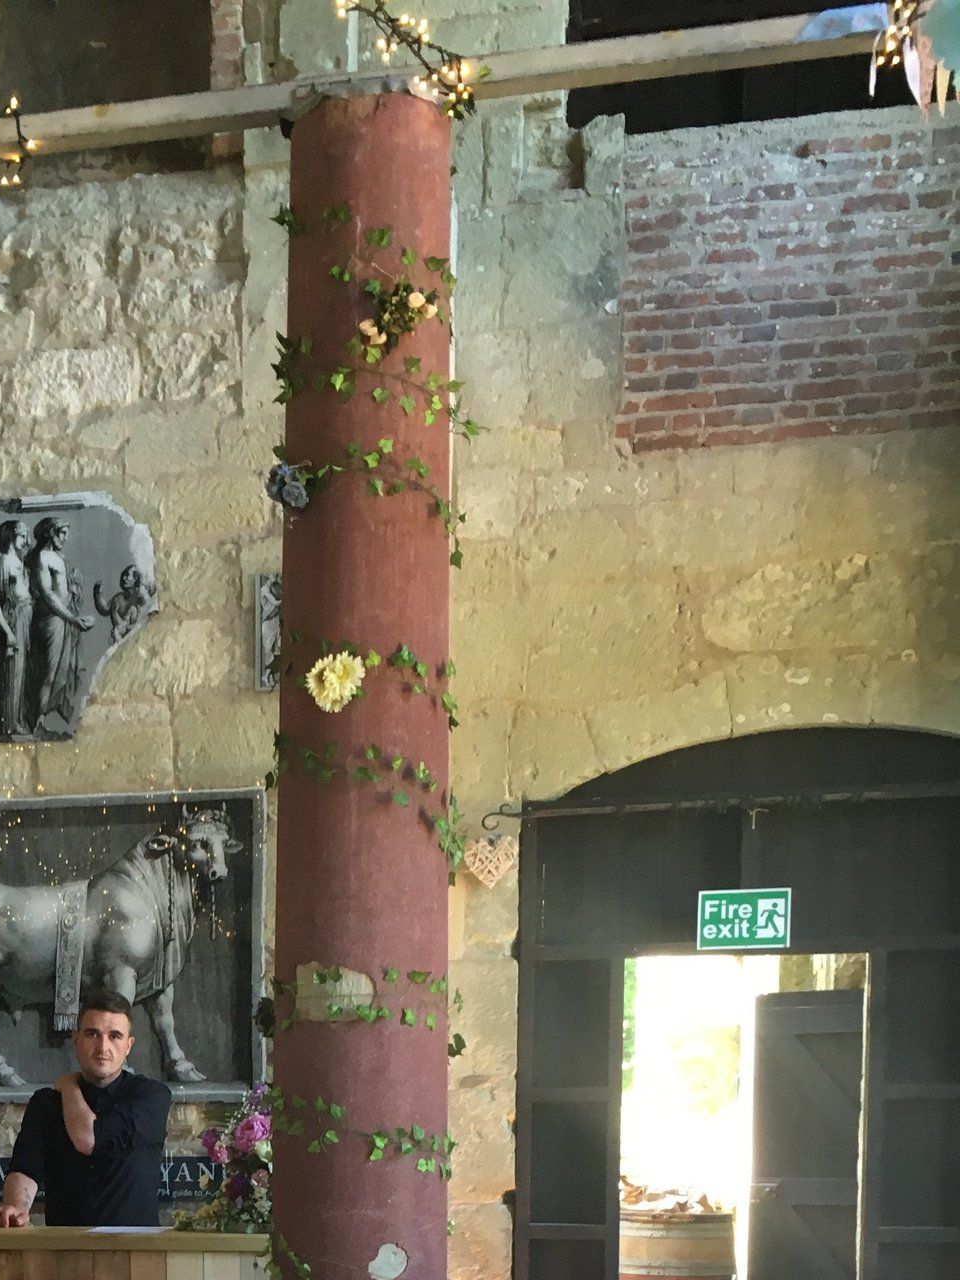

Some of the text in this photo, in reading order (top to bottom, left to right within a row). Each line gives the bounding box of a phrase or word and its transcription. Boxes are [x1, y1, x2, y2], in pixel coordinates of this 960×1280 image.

[704, 899, 753, 920] Fire
[702, 919, 750, 940] exit
[172, 1188, 193, 1199] guide
